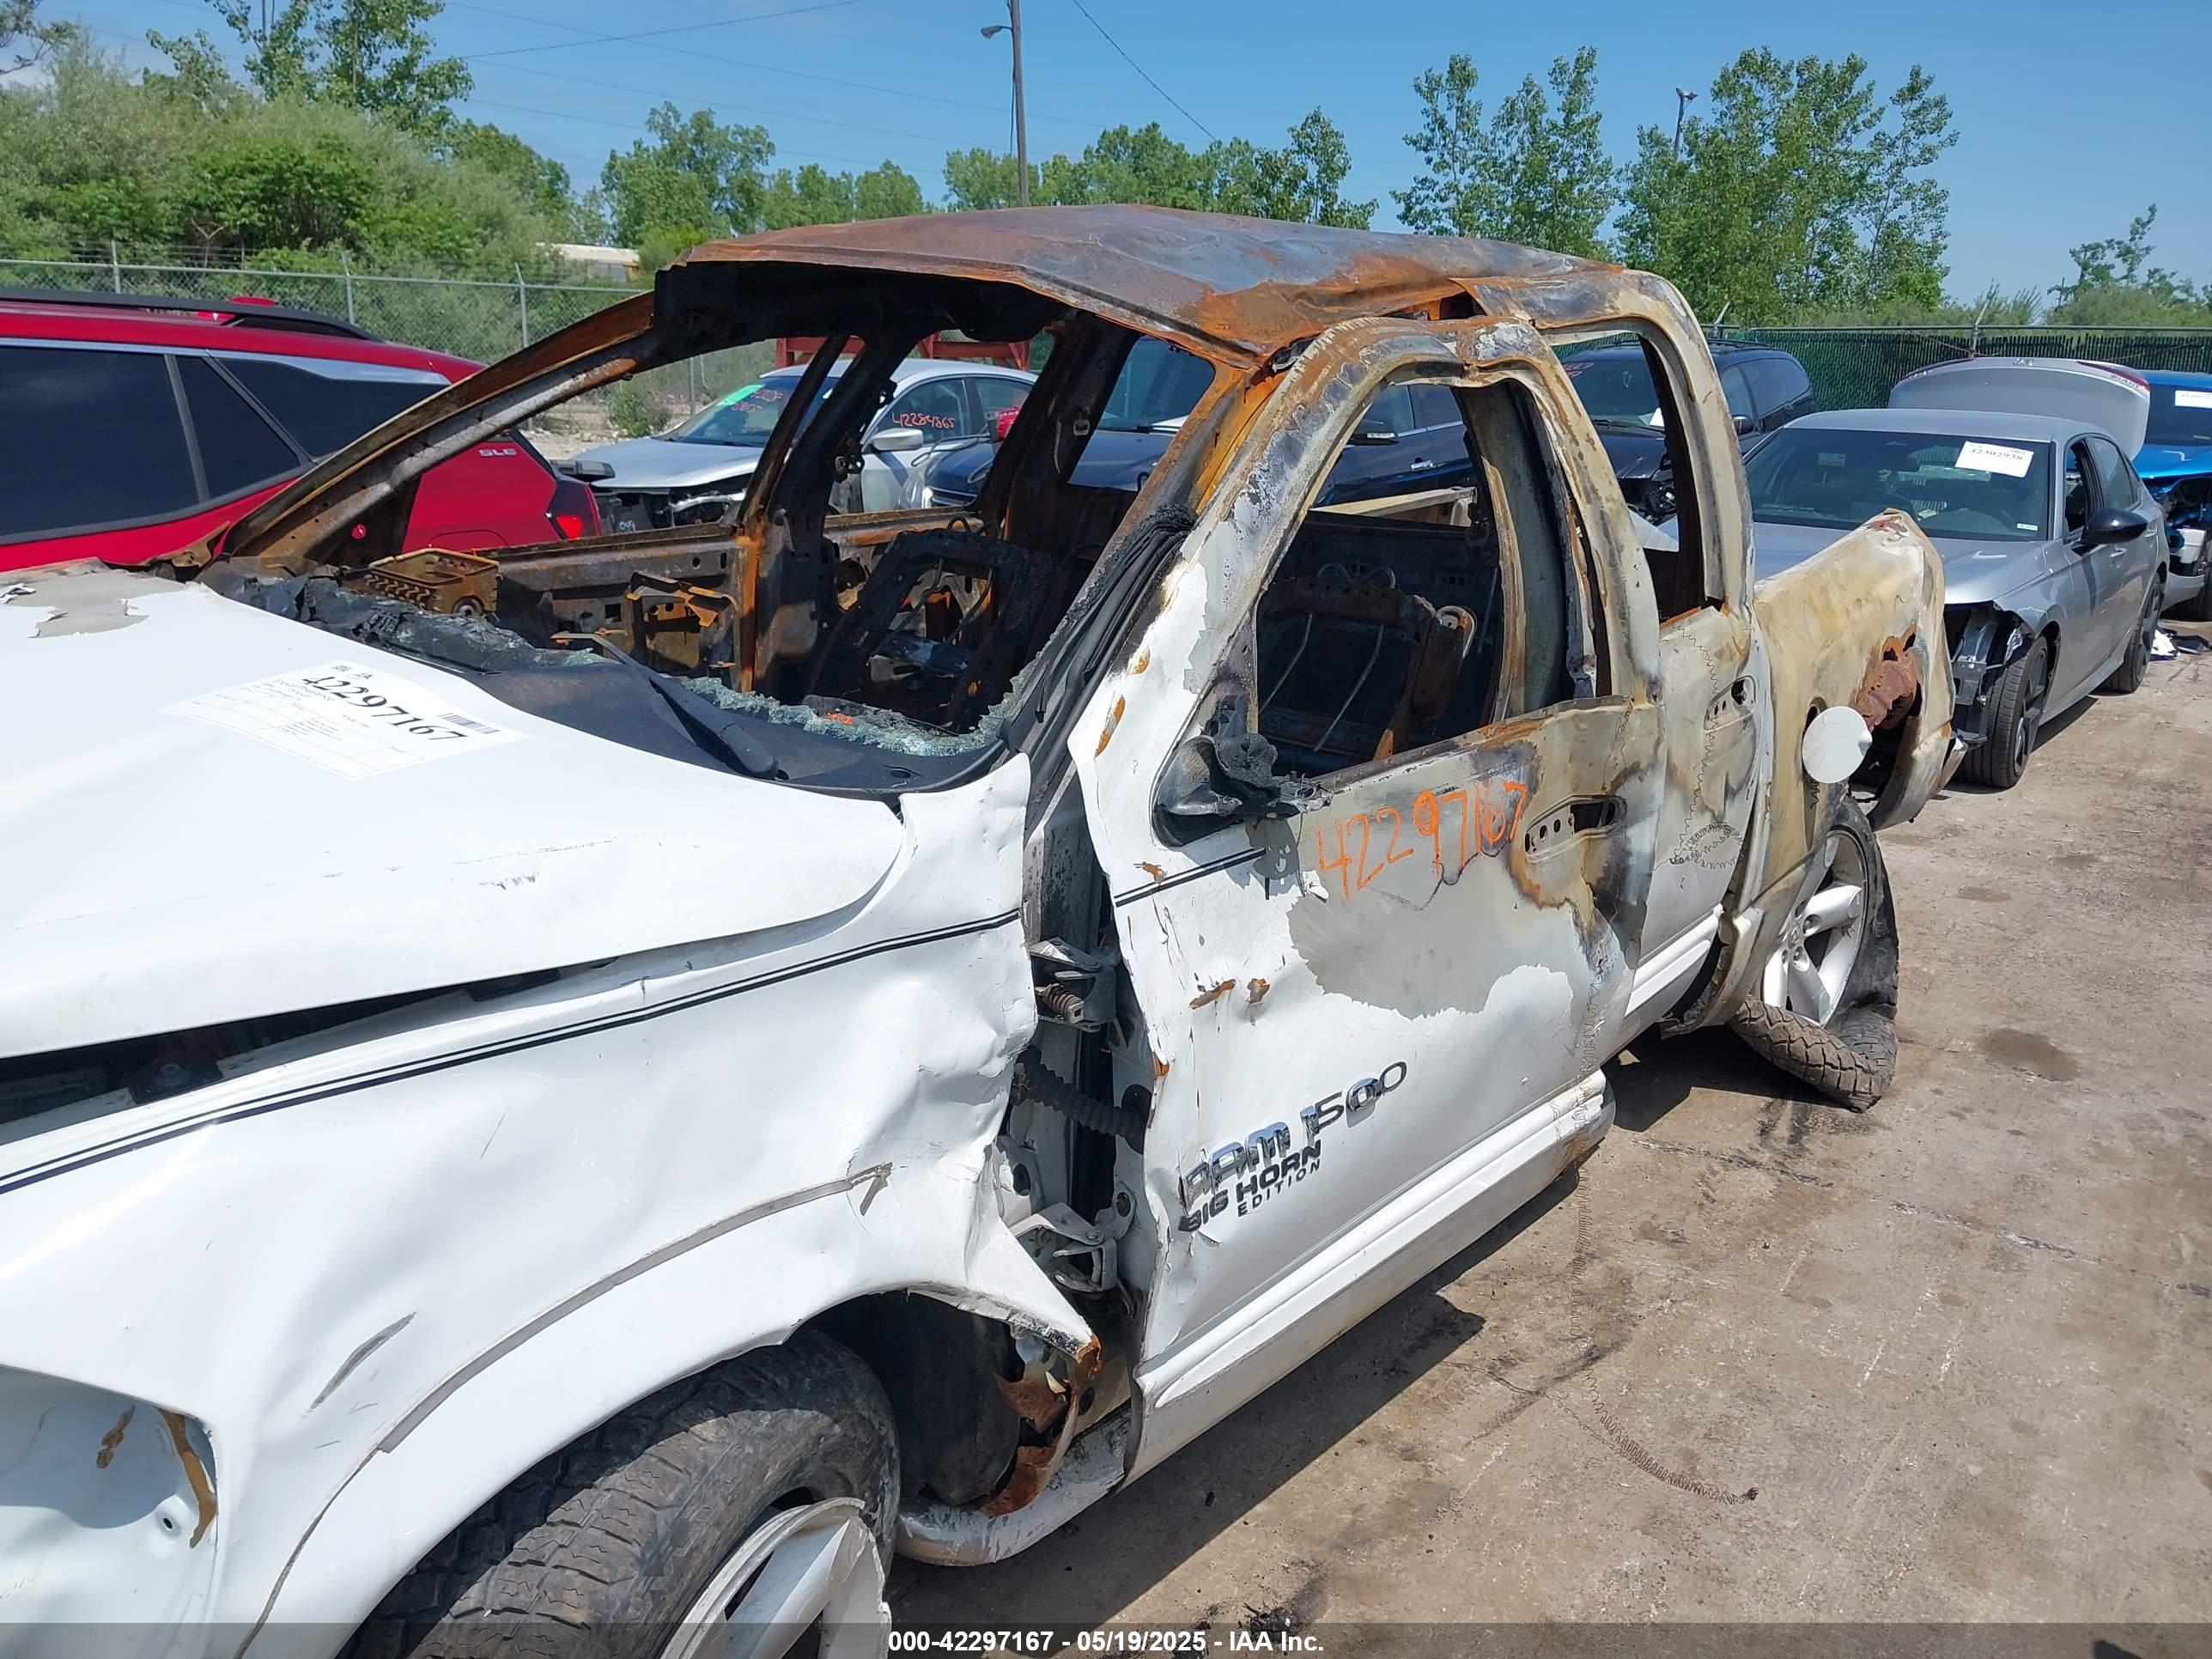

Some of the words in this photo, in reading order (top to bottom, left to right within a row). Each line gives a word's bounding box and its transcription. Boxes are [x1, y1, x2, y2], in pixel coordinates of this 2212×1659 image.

[301, 676, 469, 741] 42297167
[1317, 776, 1528, 902] 42297167
[1237, 1139, 1322, 1203] HORN
[1237, 1158, 1321, 1218] EDITION
